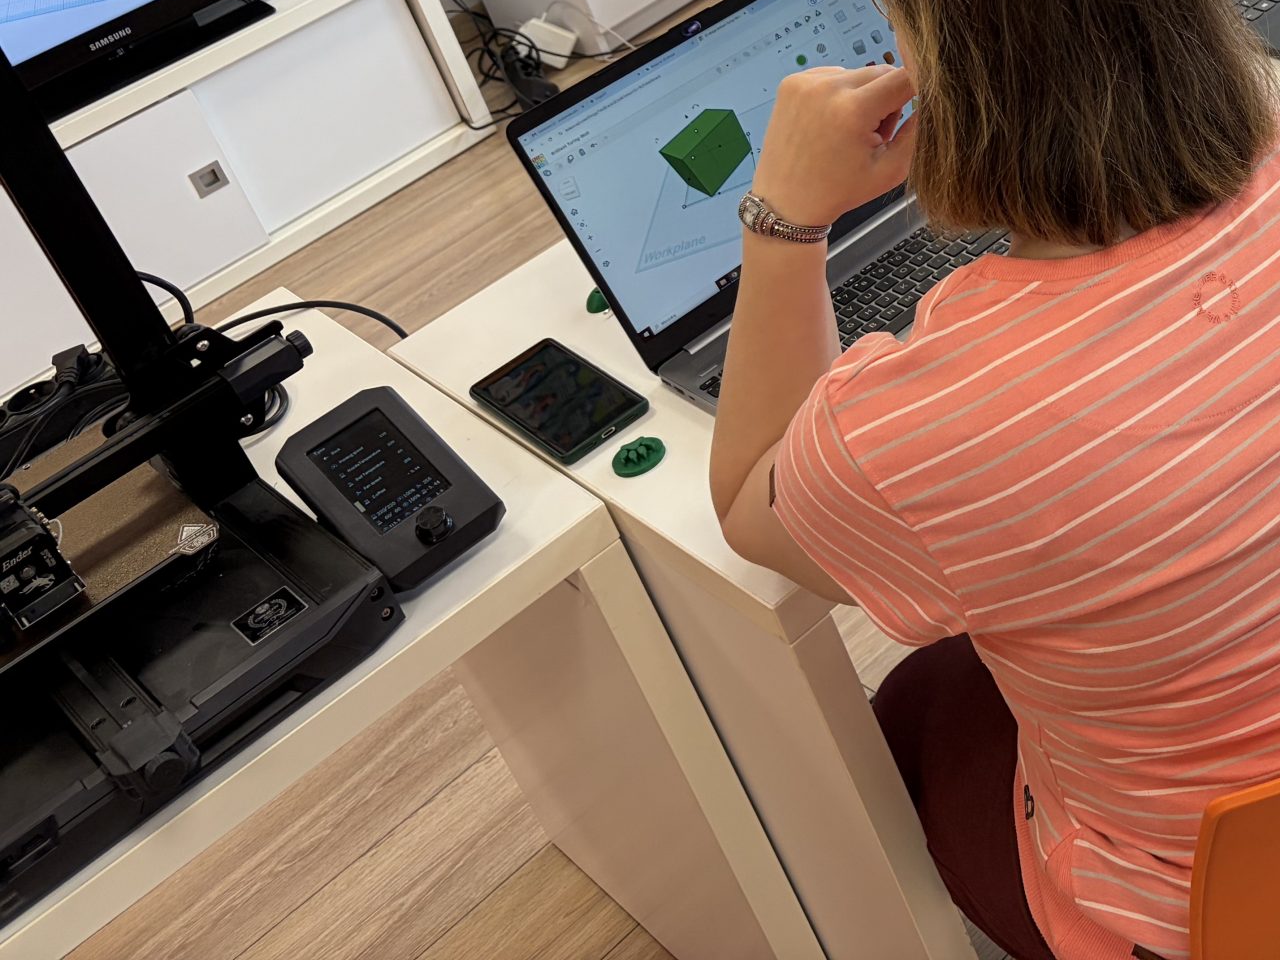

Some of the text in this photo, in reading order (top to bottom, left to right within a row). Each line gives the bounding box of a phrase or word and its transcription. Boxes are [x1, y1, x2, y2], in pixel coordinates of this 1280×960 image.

[89, 25, 132, 52] SAMSUNG
[644, 234, 706, 265] Workplane
[1, 546, 32, 572] Ender
